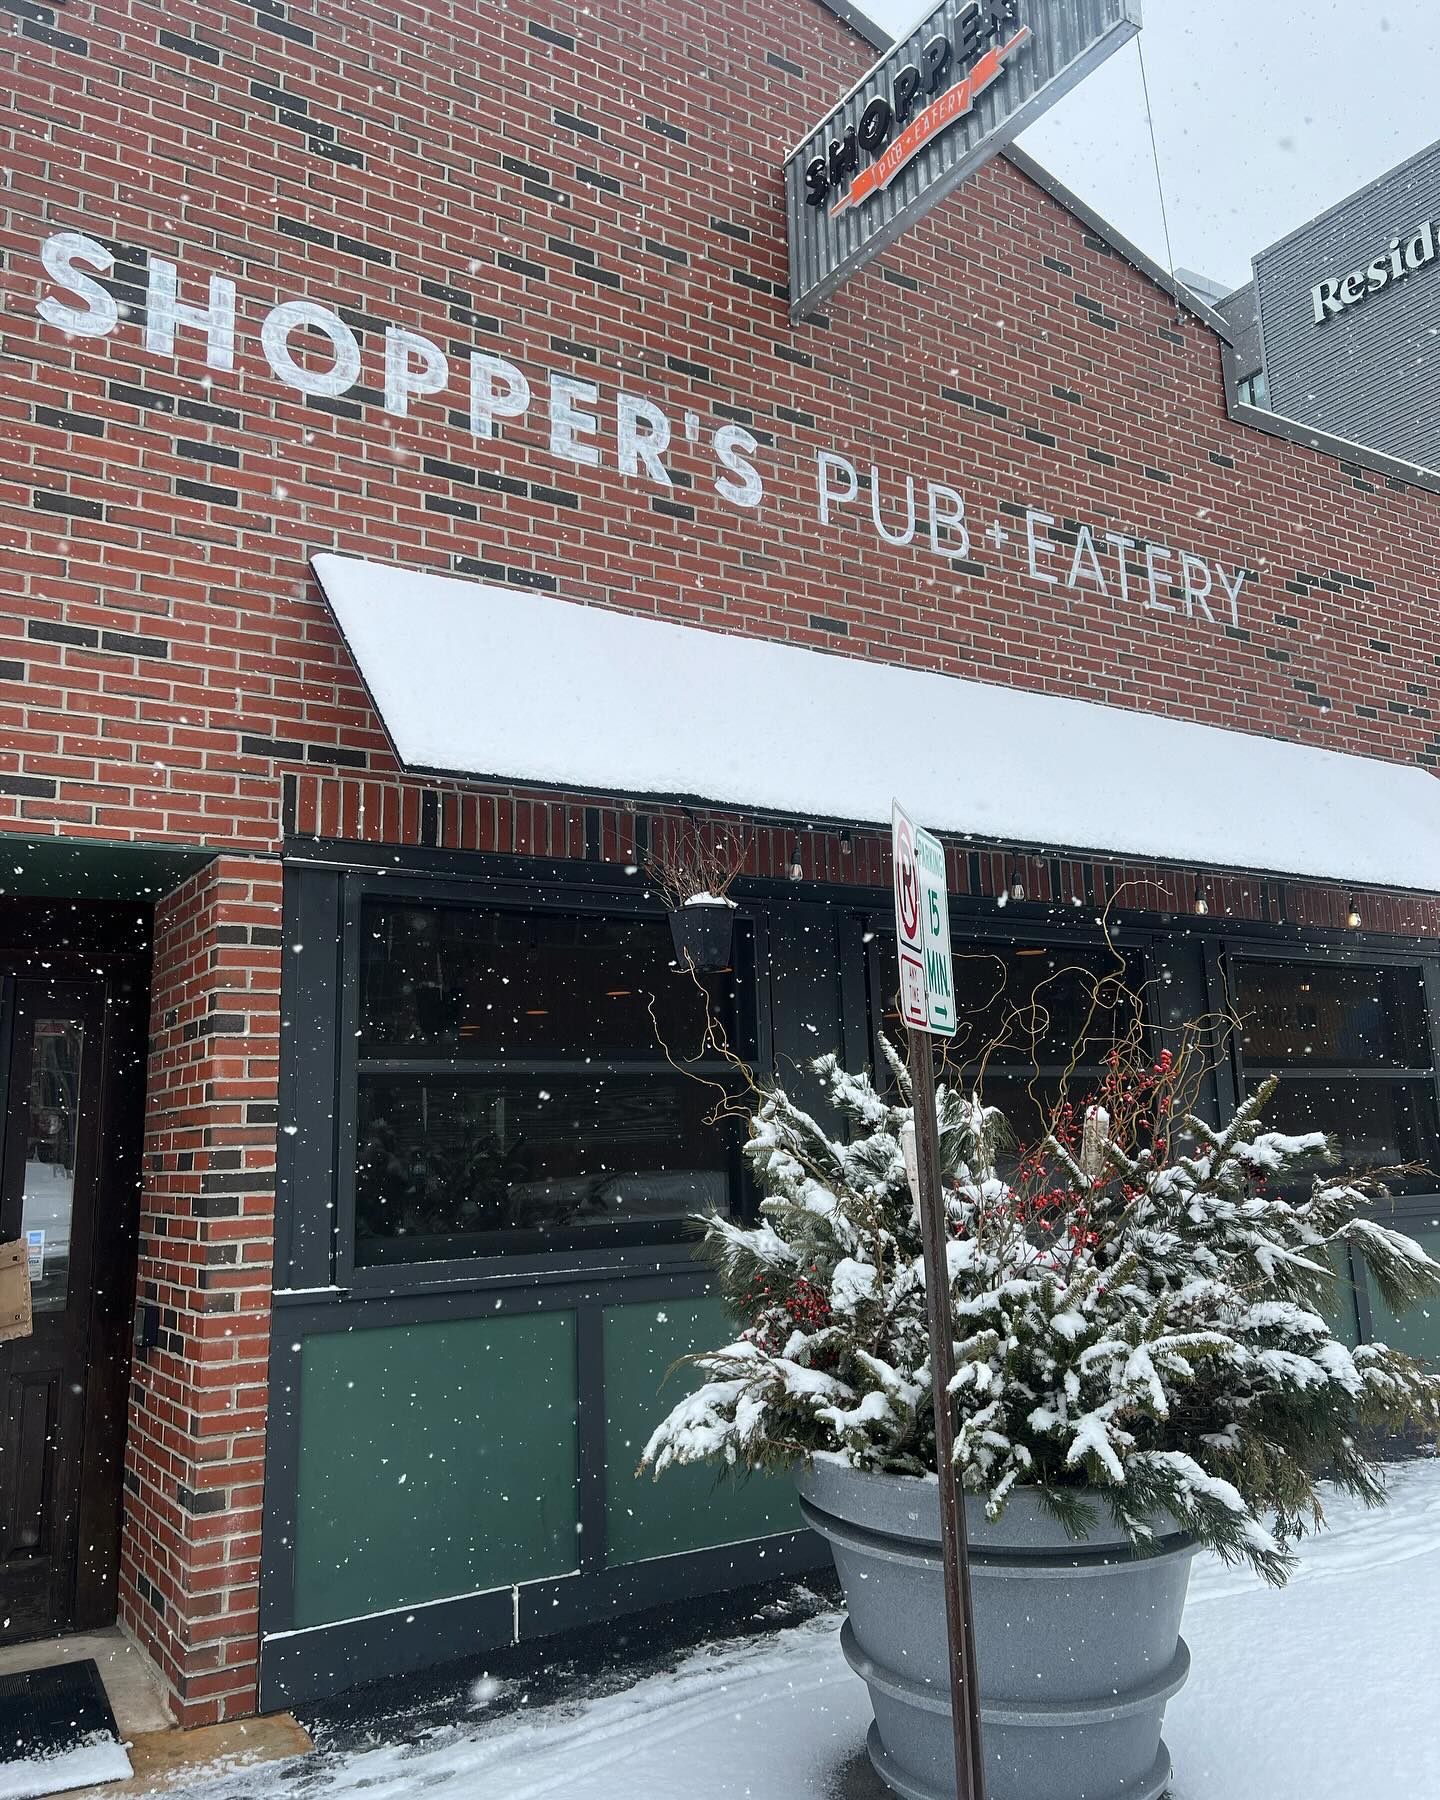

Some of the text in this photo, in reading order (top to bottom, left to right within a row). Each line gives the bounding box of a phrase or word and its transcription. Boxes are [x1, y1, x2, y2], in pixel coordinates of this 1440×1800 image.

[879, 143, 903, 178] PUB
[1310, 219, 1440, 323] Resid
[35, 232, 763, 507] SHOPPER'S
[817, 451, 970, 559] PUB
[1026, 510, 1246, 629] EATERY
